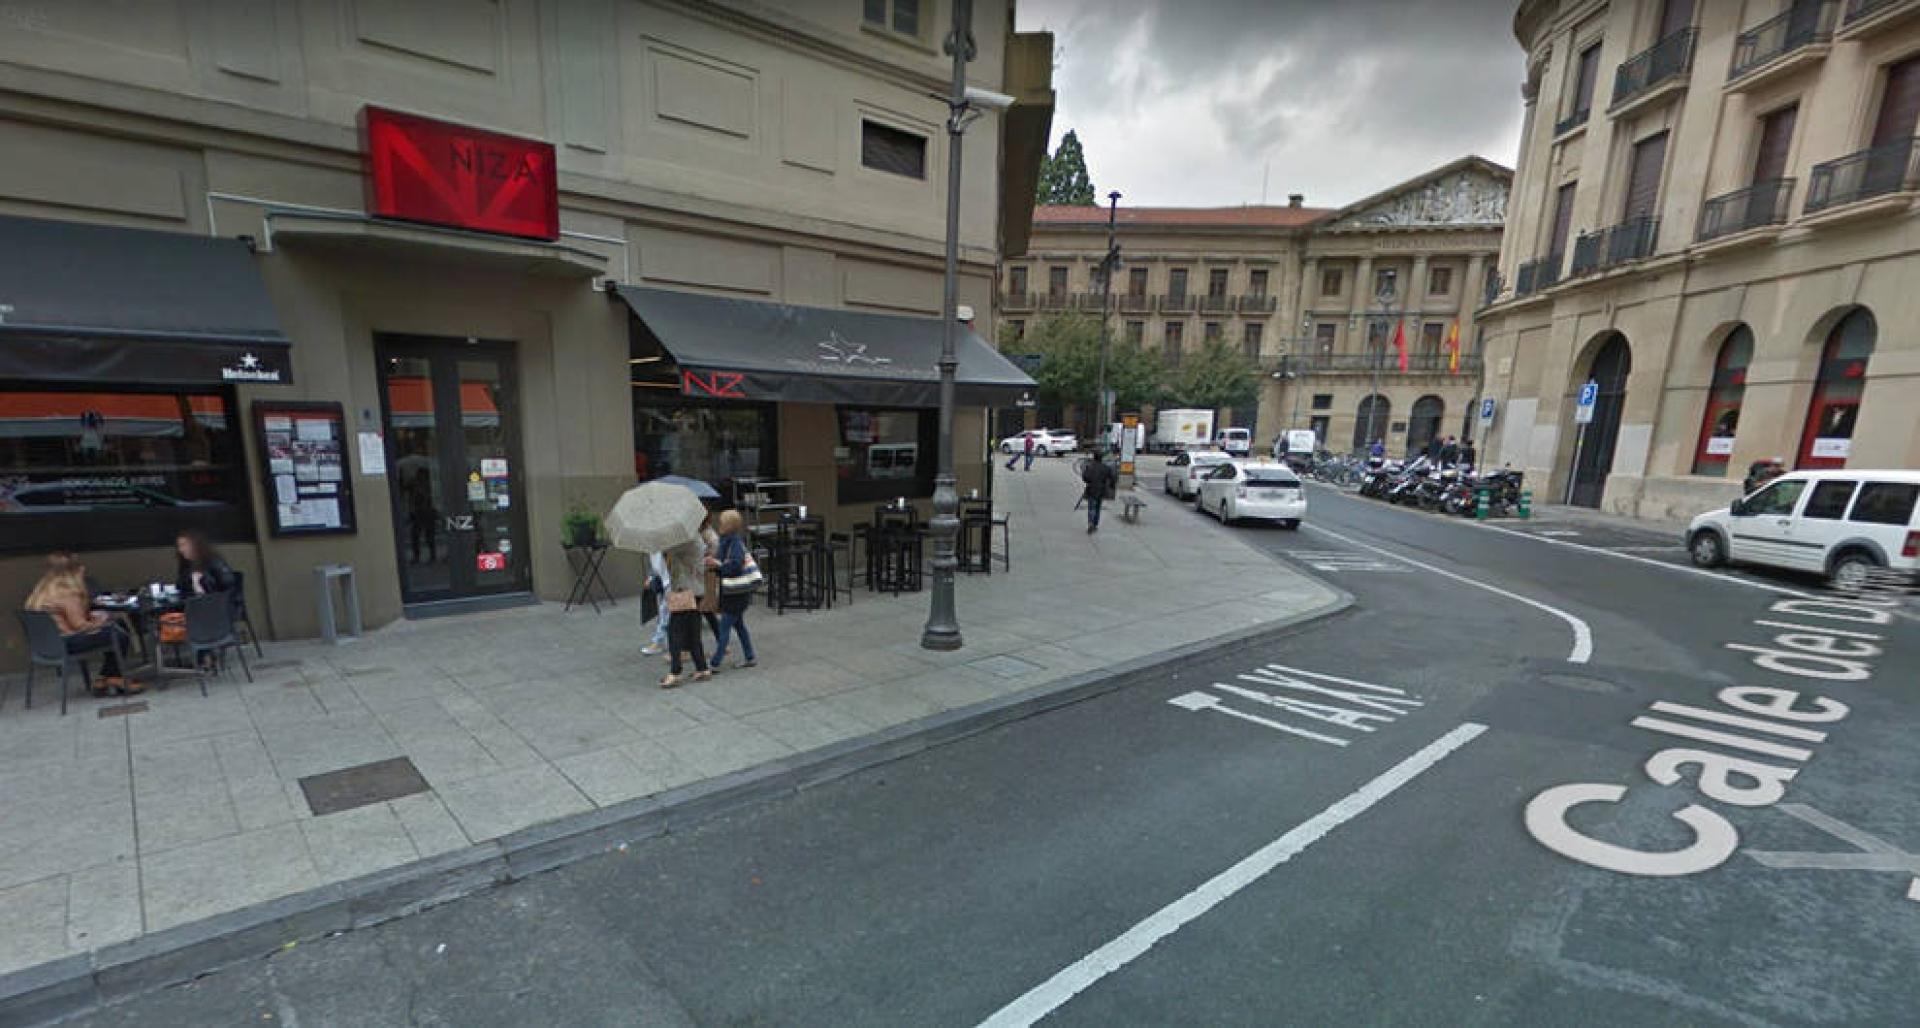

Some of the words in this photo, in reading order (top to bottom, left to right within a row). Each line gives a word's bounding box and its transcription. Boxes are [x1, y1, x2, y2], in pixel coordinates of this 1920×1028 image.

[450, 138, 539, 187] NIZA
[682, 368, 747, 398] NZ
[447, 515, 474, 530] NZ
[1167, 663, 1424, 747] TAXI
